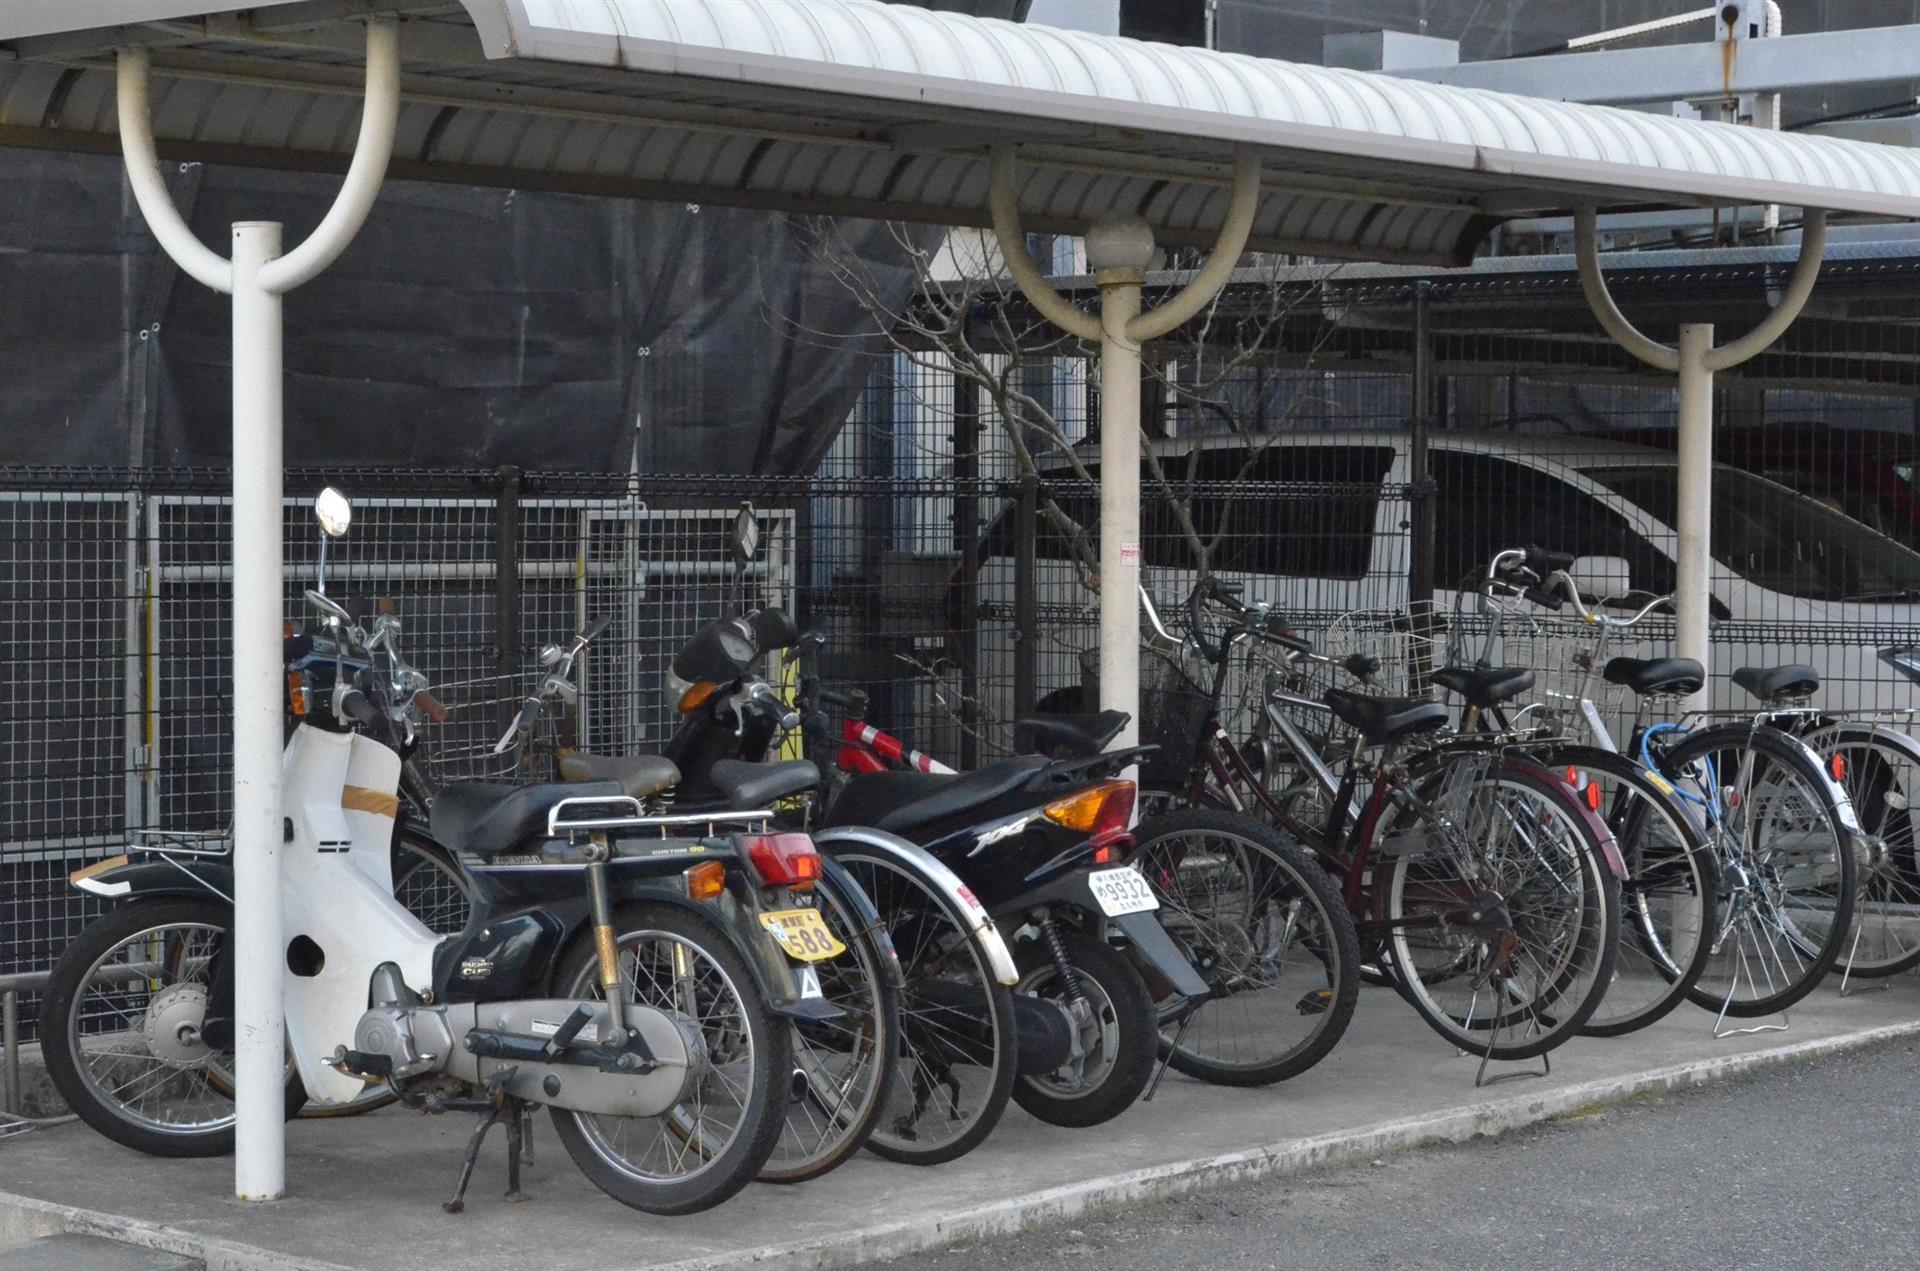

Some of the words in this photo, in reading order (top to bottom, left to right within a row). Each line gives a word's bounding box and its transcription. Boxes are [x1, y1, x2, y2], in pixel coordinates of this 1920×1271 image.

[966, 817, 1029, 858] JOG
[492, 855, 543, 865] HONDA
[651, 848, 688, 856] CUSTOM
[1105, 878, 1150, 901] 9932
[788, 928, 833, 955] 588
